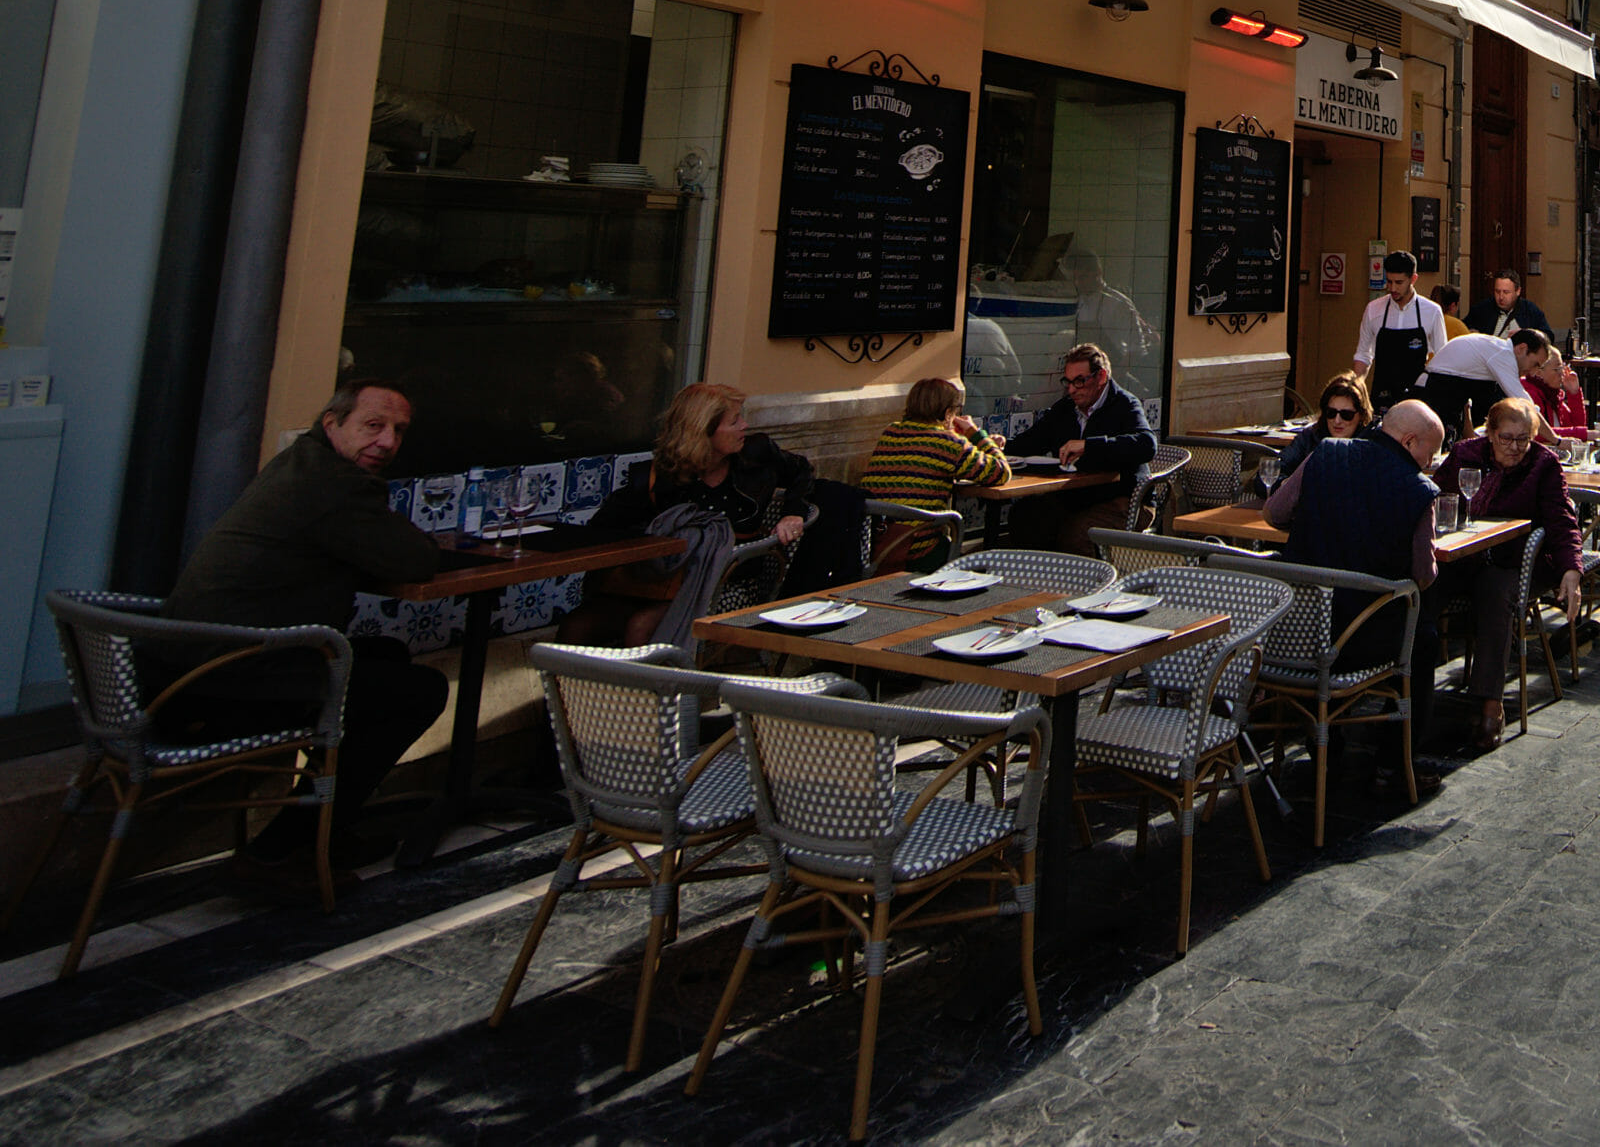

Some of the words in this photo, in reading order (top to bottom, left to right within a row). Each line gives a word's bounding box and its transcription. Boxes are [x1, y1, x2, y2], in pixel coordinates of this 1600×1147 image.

[852, 95, 864, 111] EL
[865, 94, 912, 118] MENTIDERO
[1320, 78, 1380, 112] TABERNA
[1298, 97, 1316, 120] EL
[1319, 101, 1398, 136] MENTIDERO
